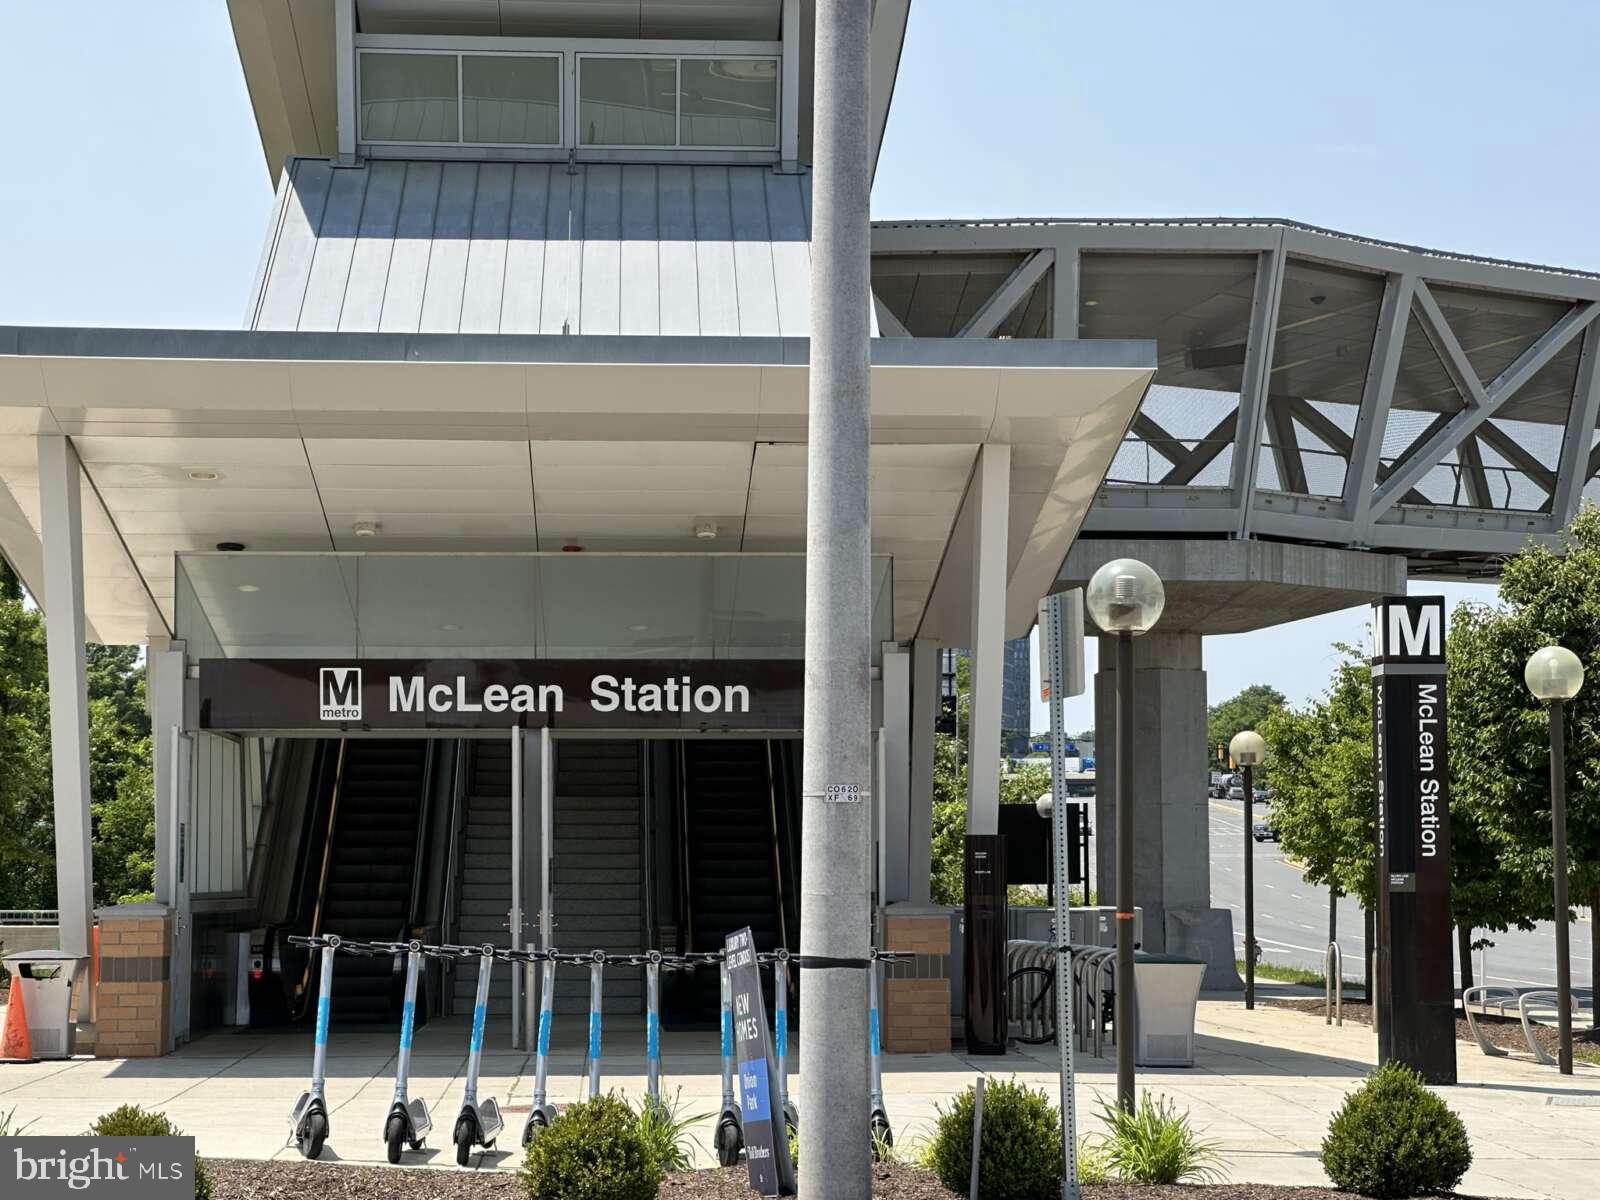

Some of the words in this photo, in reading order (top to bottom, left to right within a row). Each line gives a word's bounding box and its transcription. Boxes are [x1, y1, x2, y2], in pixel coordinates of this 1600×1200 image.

[1389, 605, 1440, 656] M
[322, 670, 359, 705] M
[389, 676, 564, 712] McLean
[590, 674, 750, 712] Station
[322, 707, 359, 719] metro
[1418, 684, 1438, 772] McLean
[1419, 778, 1441, 857] Station
